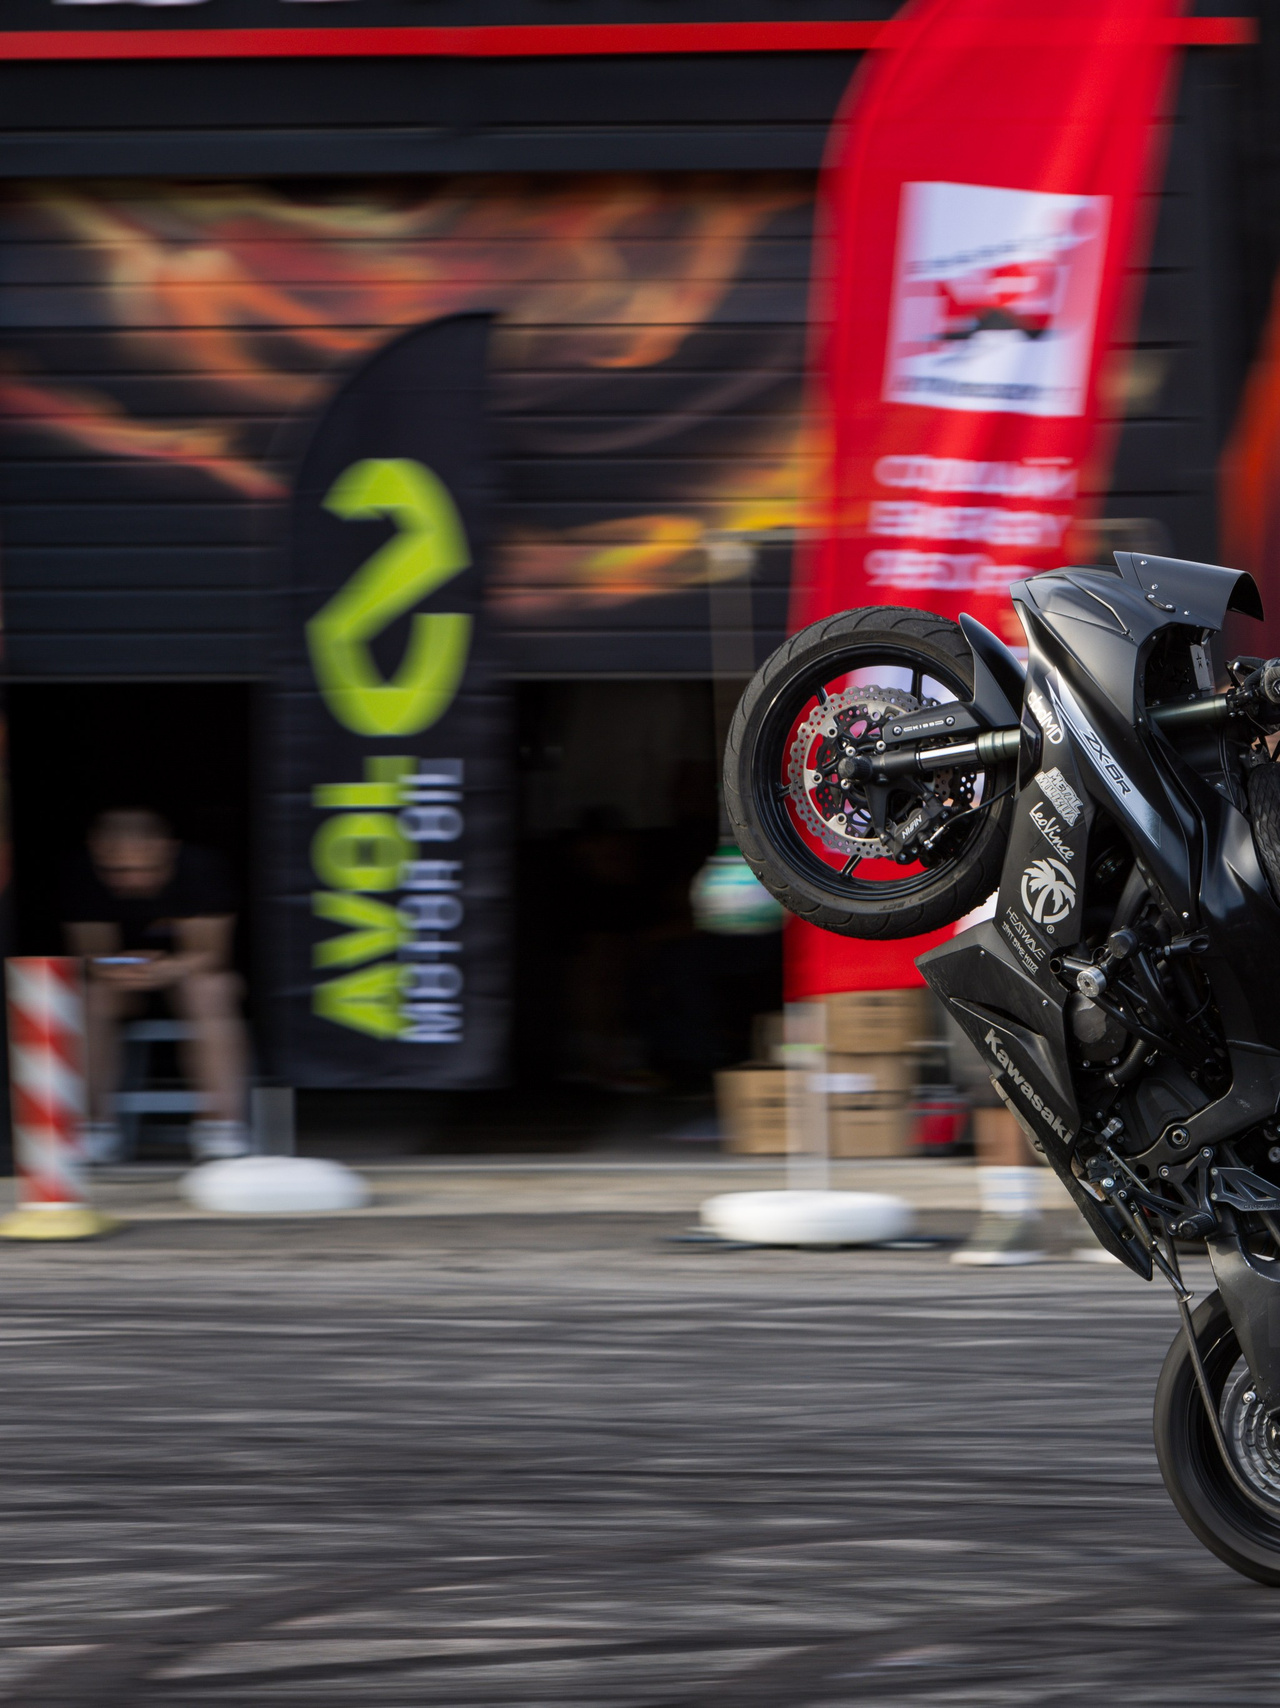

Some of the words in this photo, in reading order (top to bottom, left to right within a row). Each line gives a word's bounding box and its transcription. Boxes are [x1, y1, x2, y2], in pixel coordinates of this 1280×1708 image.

[1028, 691, 1064, 745] cbdMD
[1046, 767, 1083, 814] METAL
[1082, 731, 1131, 795] ZX-6R
[396, 757, 463, 841] OIL
[1029, 801, 1075, 862] LeoVince
[396, 859, 463, 1042] MOTOR
[1005, 906, 1047, 962] HEATWAVE
[984, 1028, 1075, 1145] Kawasaki
